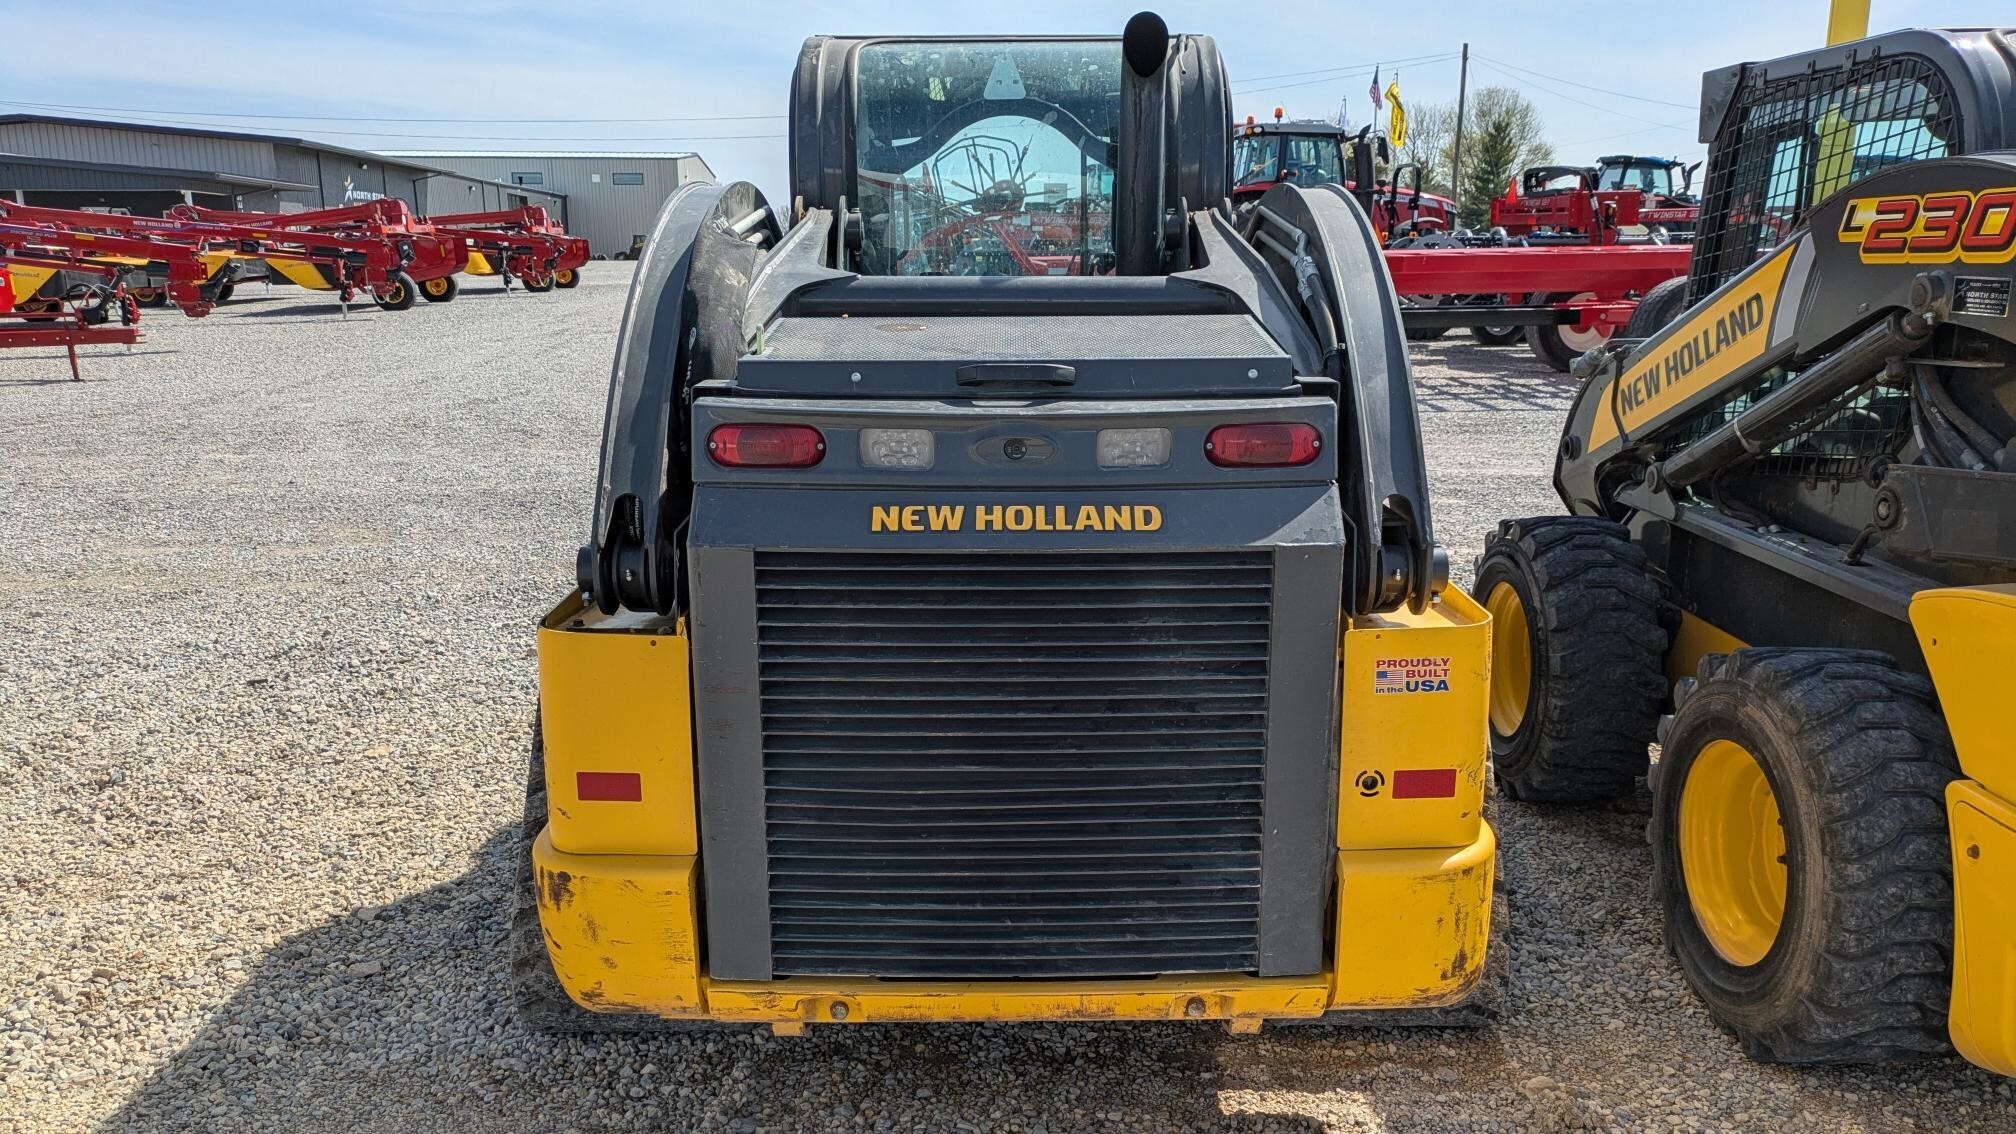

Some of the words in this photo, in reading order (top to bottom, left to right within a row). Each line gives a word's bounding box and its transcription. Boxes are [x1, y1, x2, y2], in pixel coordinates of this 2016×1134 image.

[353, 191, 371, 200] NORTH
[1647, 211, 1687, 219] TWINSTAR
[1840, 188, 2016, 258] L230
[1620, 362, 1660, 416] NEW
[1665, 292, 1764, 387] HOLLAND
[871, 505, 964, 532] NEW
[975, 505, 1163, 531] HOLLAND
[1376, 658, 1450, 668] PROUDLY
[1405, 669, 1450, 678] BUILT
[1405, 680, 1449, 692] USA
